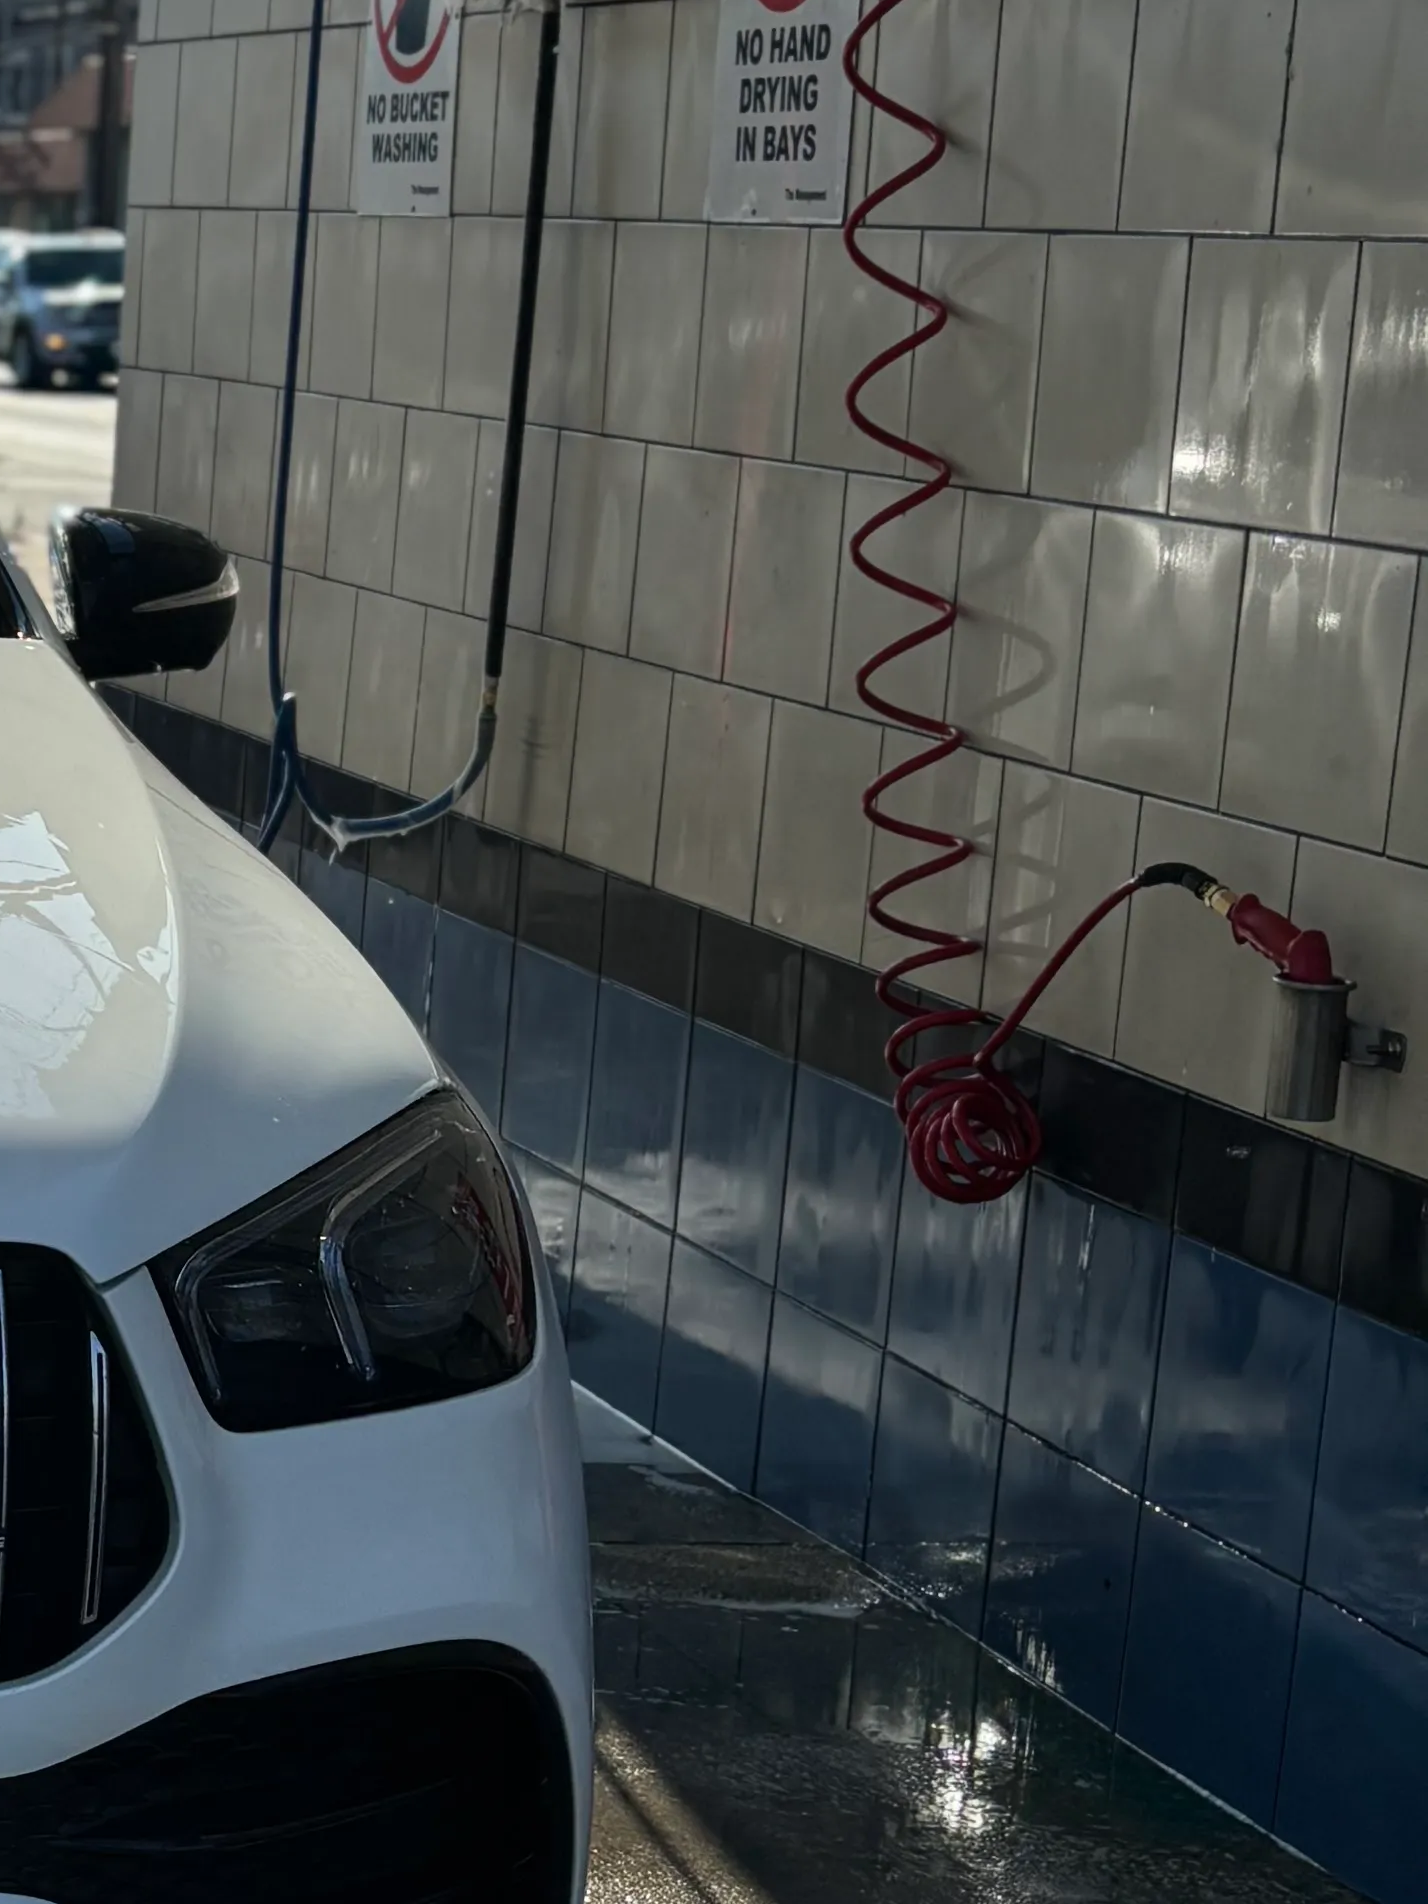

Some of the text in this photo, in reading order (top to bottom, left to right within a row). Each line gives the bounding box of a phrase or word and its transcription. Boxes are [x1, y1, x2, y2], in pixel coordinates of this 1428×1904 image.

[735, 23, 831, 66] NO HAND
[366, 91, 450, 125] NO BUCKET
[739, 74, 818, 113] DRYING
[372, 131, 439, 164] WASHING
[735, 123, 817, 162] IN BAYS
